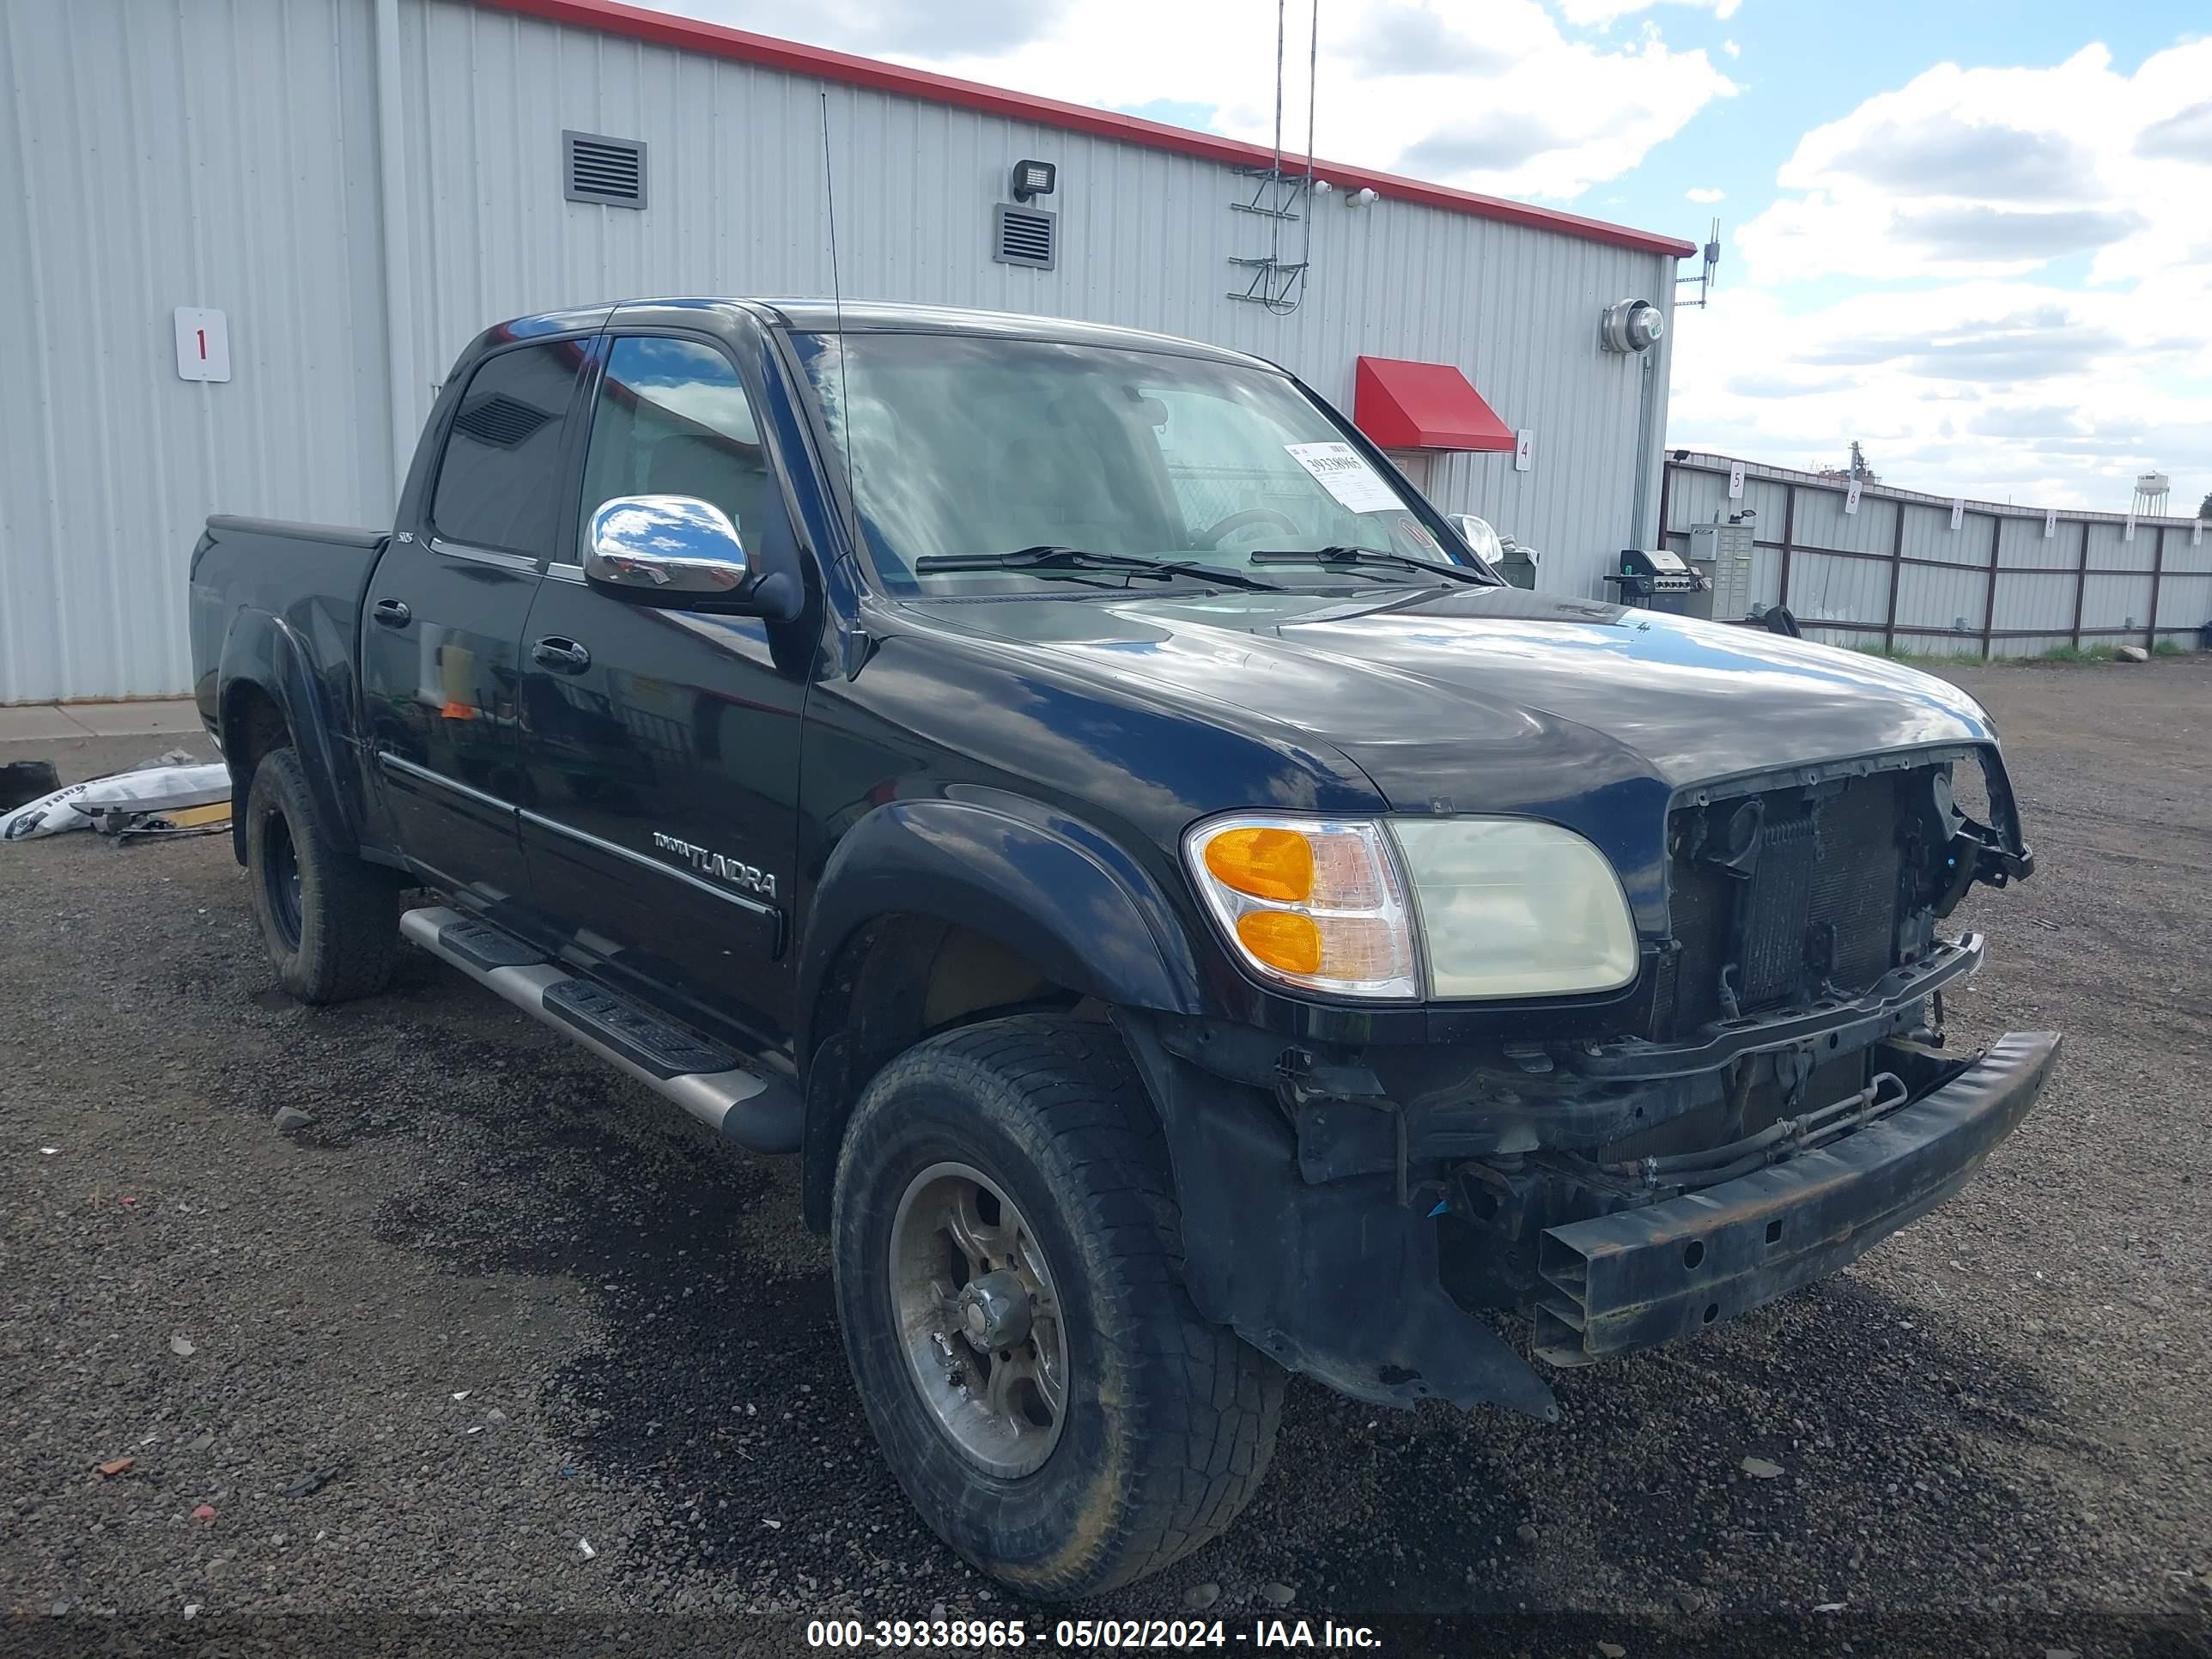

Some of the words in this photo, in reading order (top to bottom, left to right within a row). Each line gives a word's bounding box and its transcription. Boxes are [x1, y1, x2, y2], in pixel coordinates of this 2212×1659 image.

[197, 329, 206, 360] 1
[1521, 441, 1528, 459] 4
[1306, 456, 1363, 472] 39338965
[1734, 472, 1741, 488] 5
[1850, 490, 1856, 504] 6
[1955, 507, 1960, 520] 7
[2048, 517, 2053, 529] 8
[653, 831, 690, 858] TOYOTA
[688, 843, 777, 899] TUNDRA
